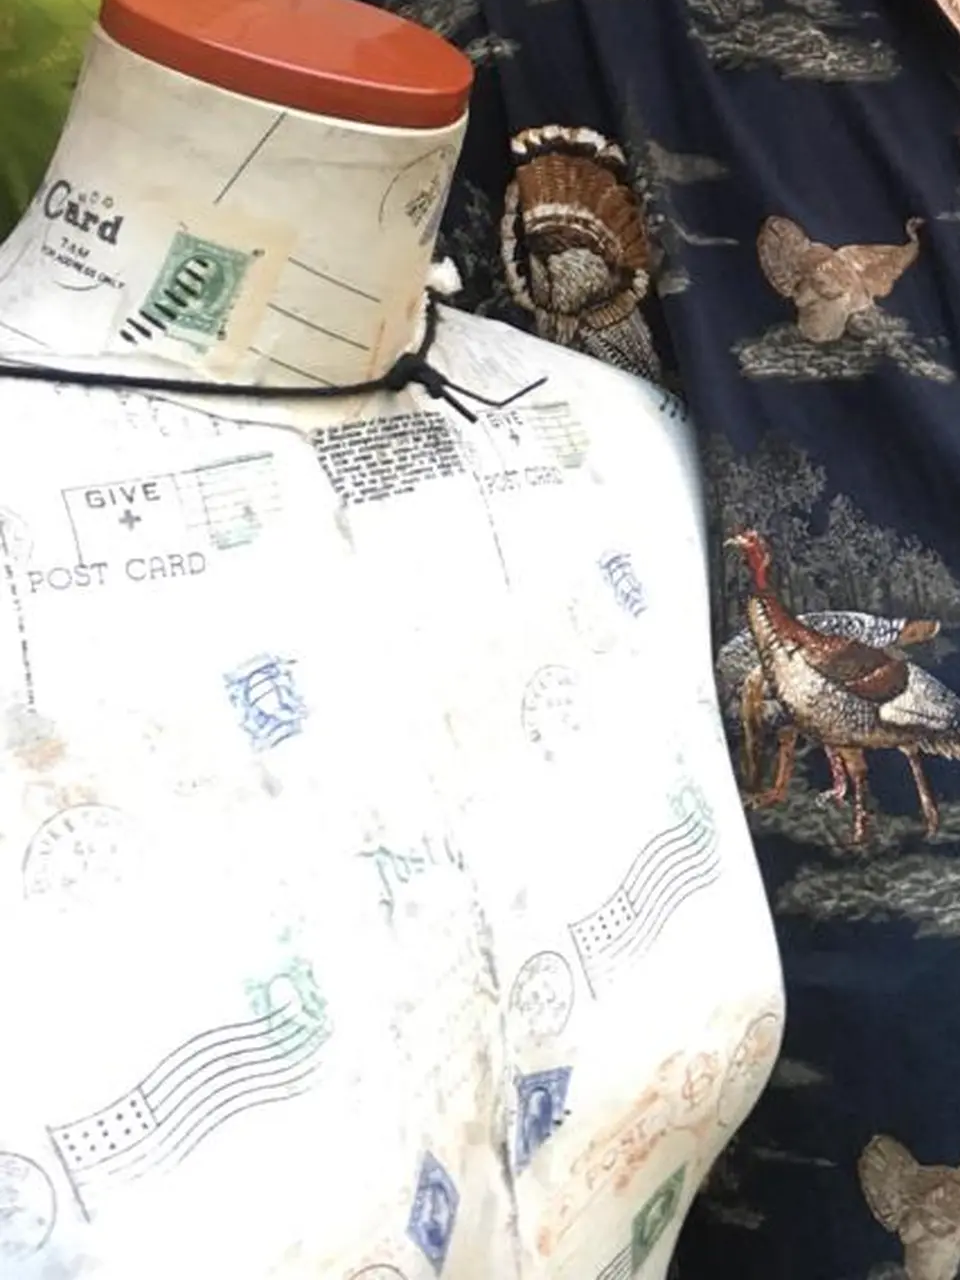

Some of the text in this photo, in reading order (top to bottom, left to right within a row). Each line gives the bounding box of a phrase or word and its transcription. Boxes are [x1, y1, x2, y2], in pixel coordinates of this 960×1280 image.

[44, 180, 124, 245] Card
[98, 273, 126, 289] ONLY
[84, 481, 162, 510] GIVE
[27, 551, 207, 594] POST CARD
